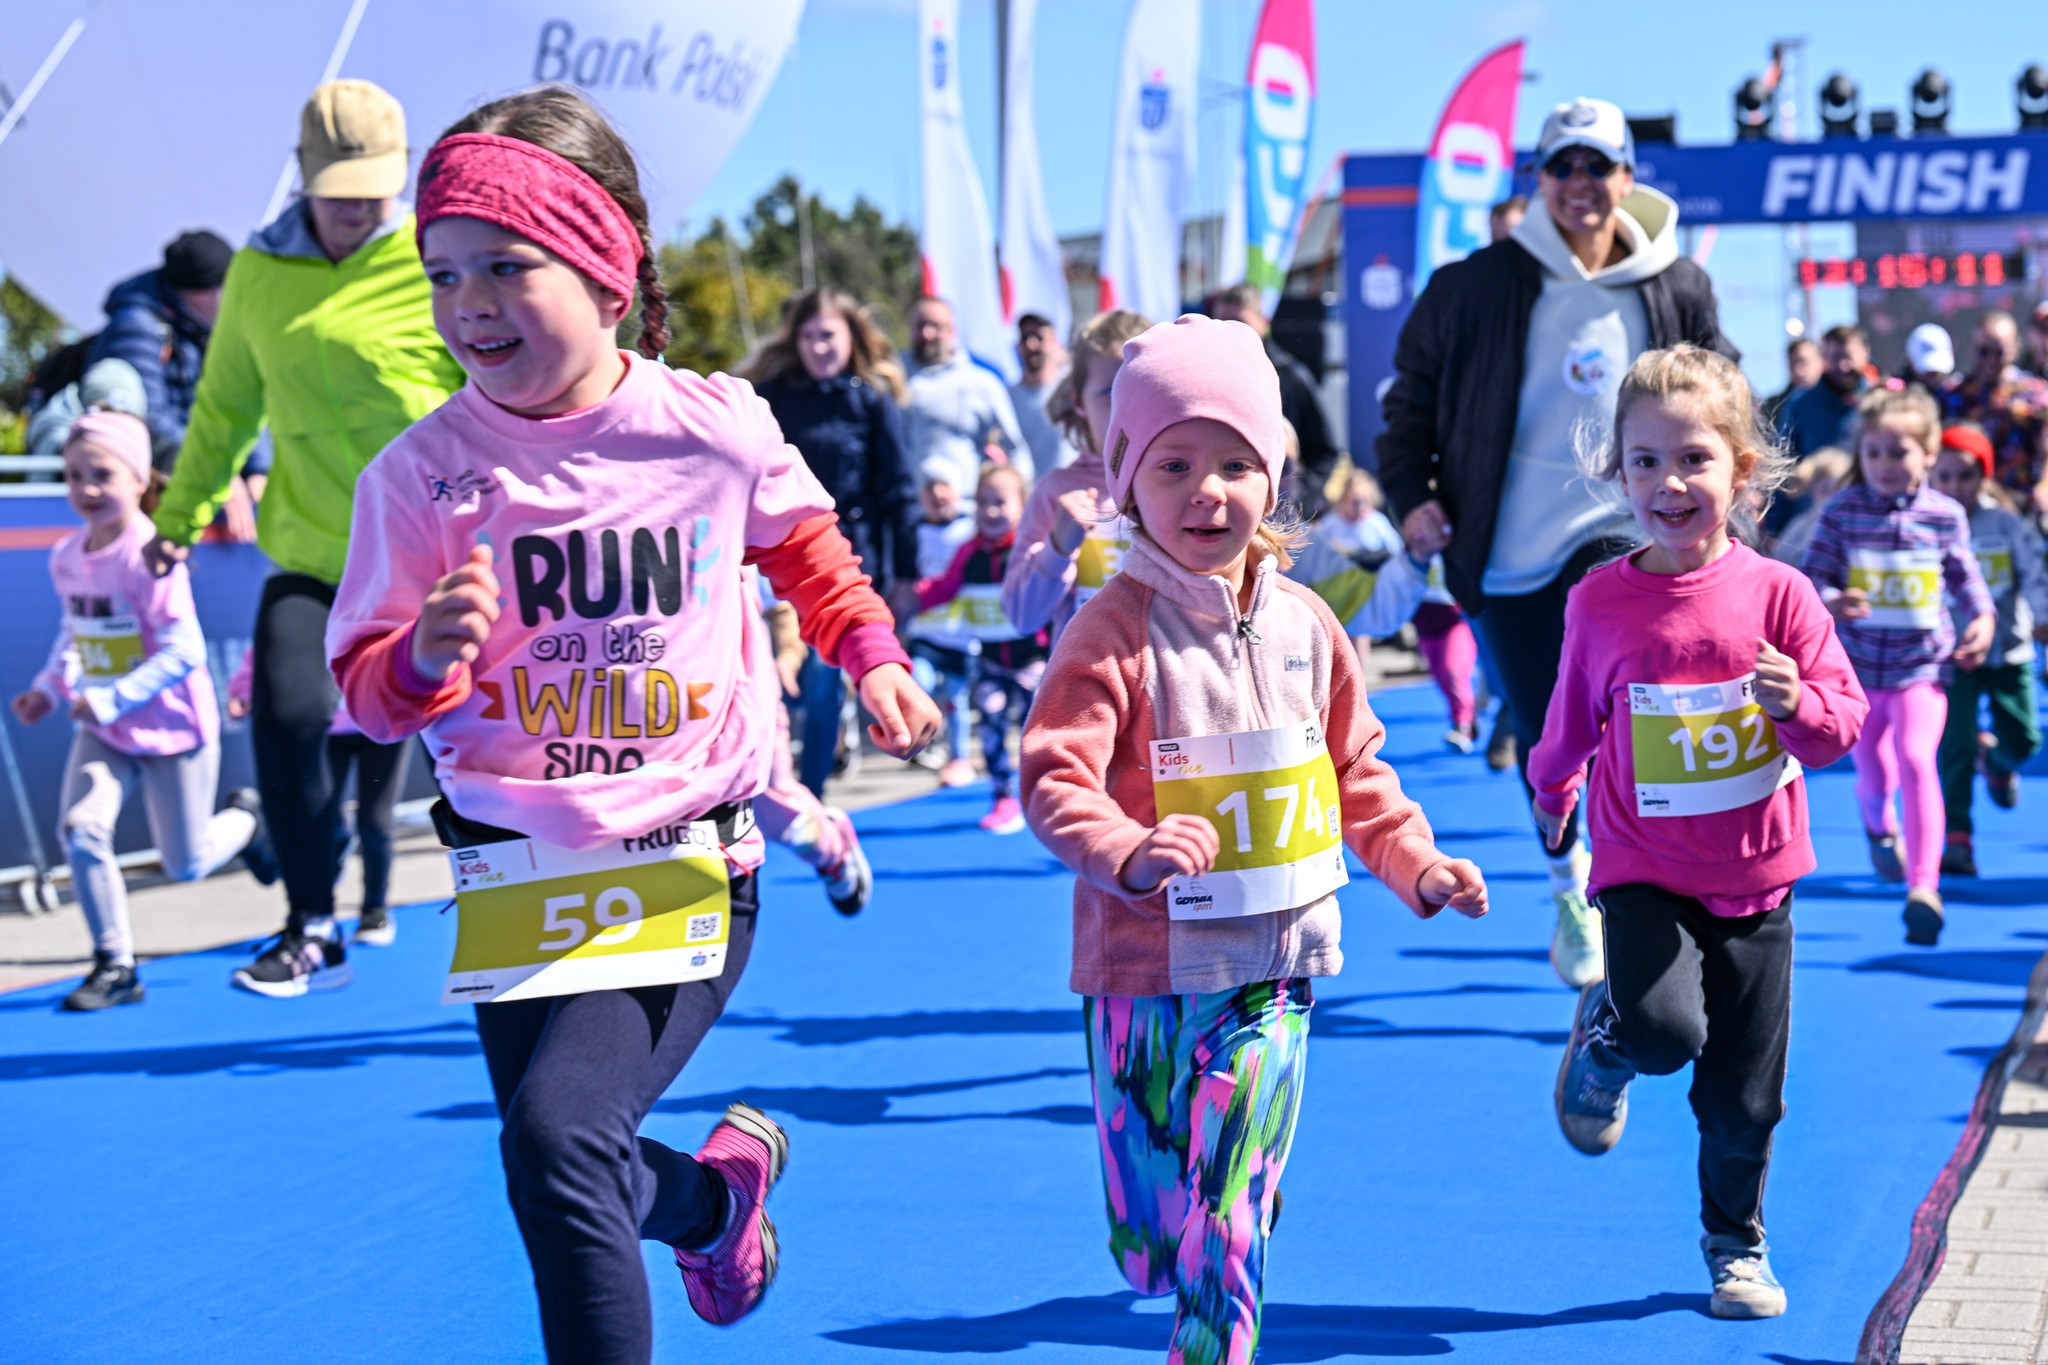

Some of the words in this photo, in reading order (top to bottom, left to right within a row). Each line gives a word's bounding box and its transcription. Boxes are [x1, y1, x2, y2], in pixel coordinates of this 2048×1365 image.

[533, 19, 668, 94] Bank
[1762, 149, 2030, 215] FINISH
[512, 526, 682, 628] RUN
[1864, 573, 1924, 604] 260
[530, 633, 586, 662] on
[602, 624, 666, 662] the
[1159, 753, 1190, 767] Kids
[1669, 714, 1769, 772] 192
[1215, 777, 1325, 853] 174
[459, 860, 489, 876] Kids
[539, 887, 643, 951] 59
